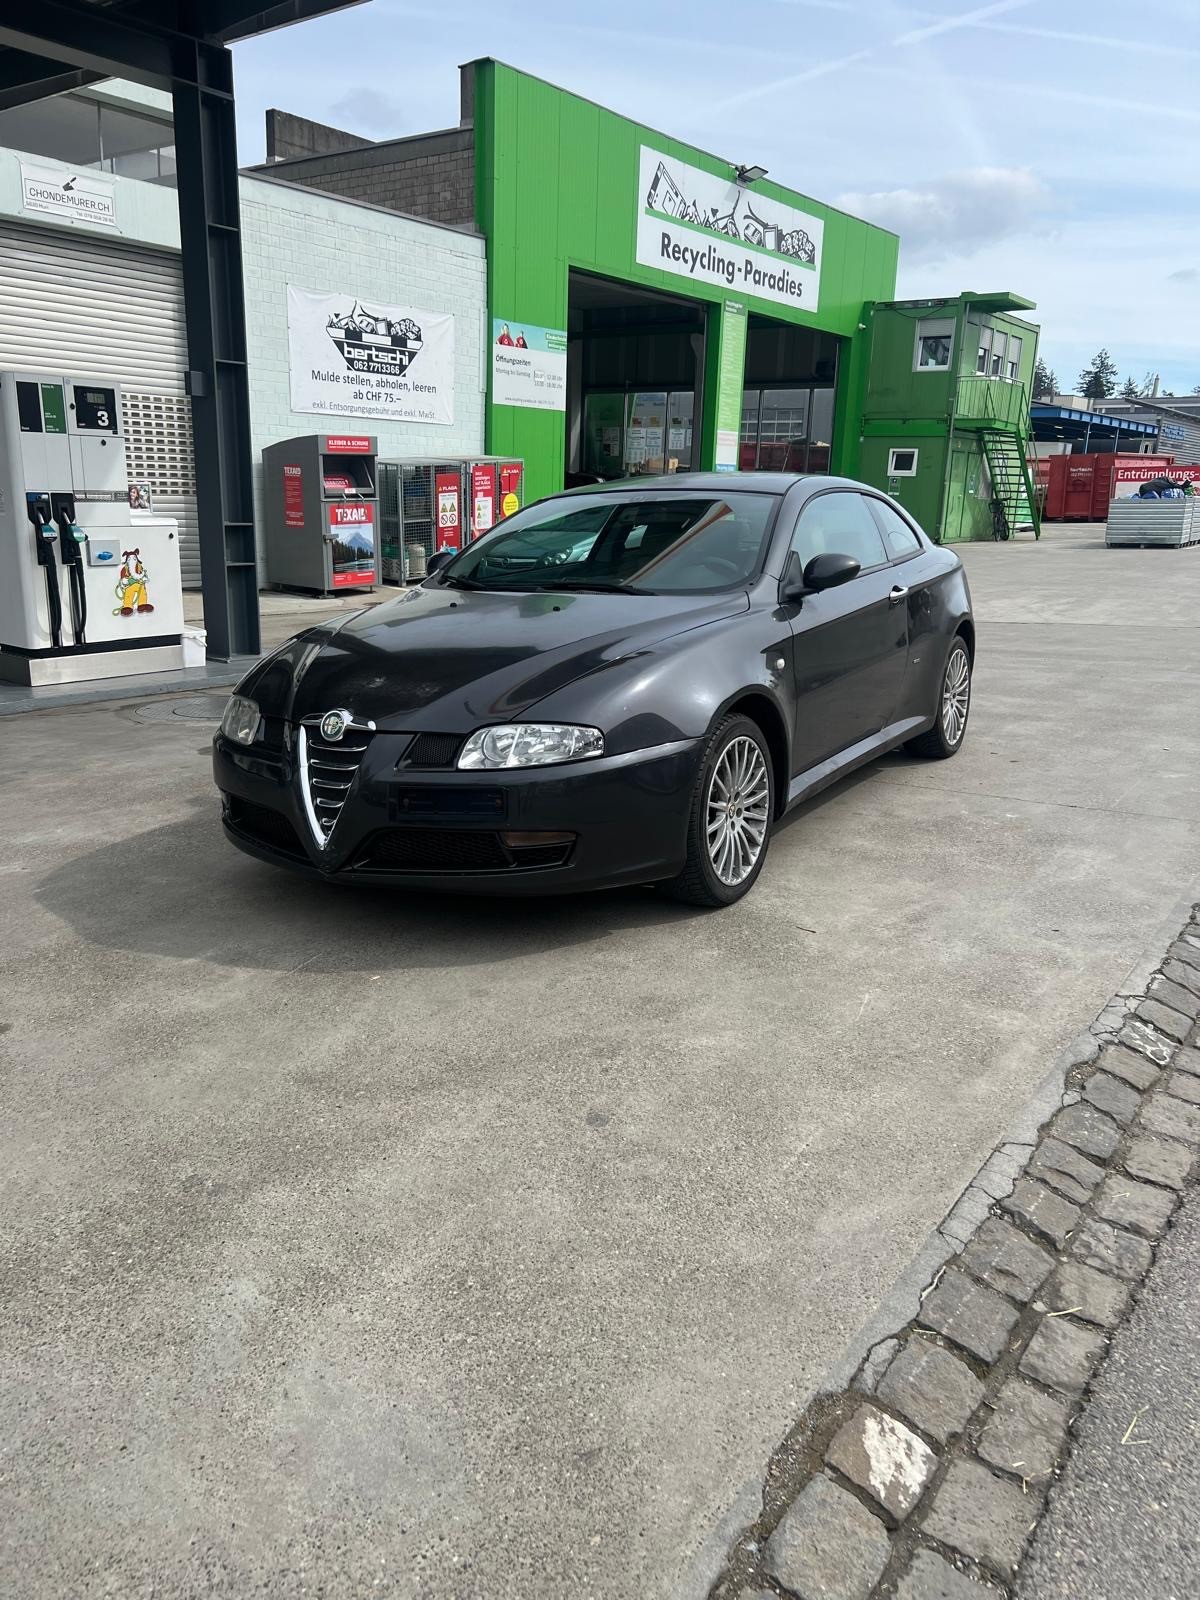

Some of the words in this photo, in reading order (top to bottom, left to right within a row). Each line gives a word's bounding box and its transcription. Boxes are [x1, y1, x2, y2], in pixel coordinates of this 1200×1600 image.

[29, 187, 110, 212] CHONDEMURER.CH
[344, 342, 409, 366] bertschi
[353, 360, 368, 371] 062
[369, 362, 400, 375] 7713366
[311, 369, 341, 384] Mulde
[343, 375, 374, 389] stellen,
[375, 378, 411, 393] abholen,
[413, 381, 437, 394] leeren
[353, 389, 364, 400] ab
[366, 391, 382, 402] CHF
[312, 400, 328, 409] exkl.
[391, 407, 403, 417] und
[404, 408, 417, 418] exkl.
[97, 410, 109, 427] 3
